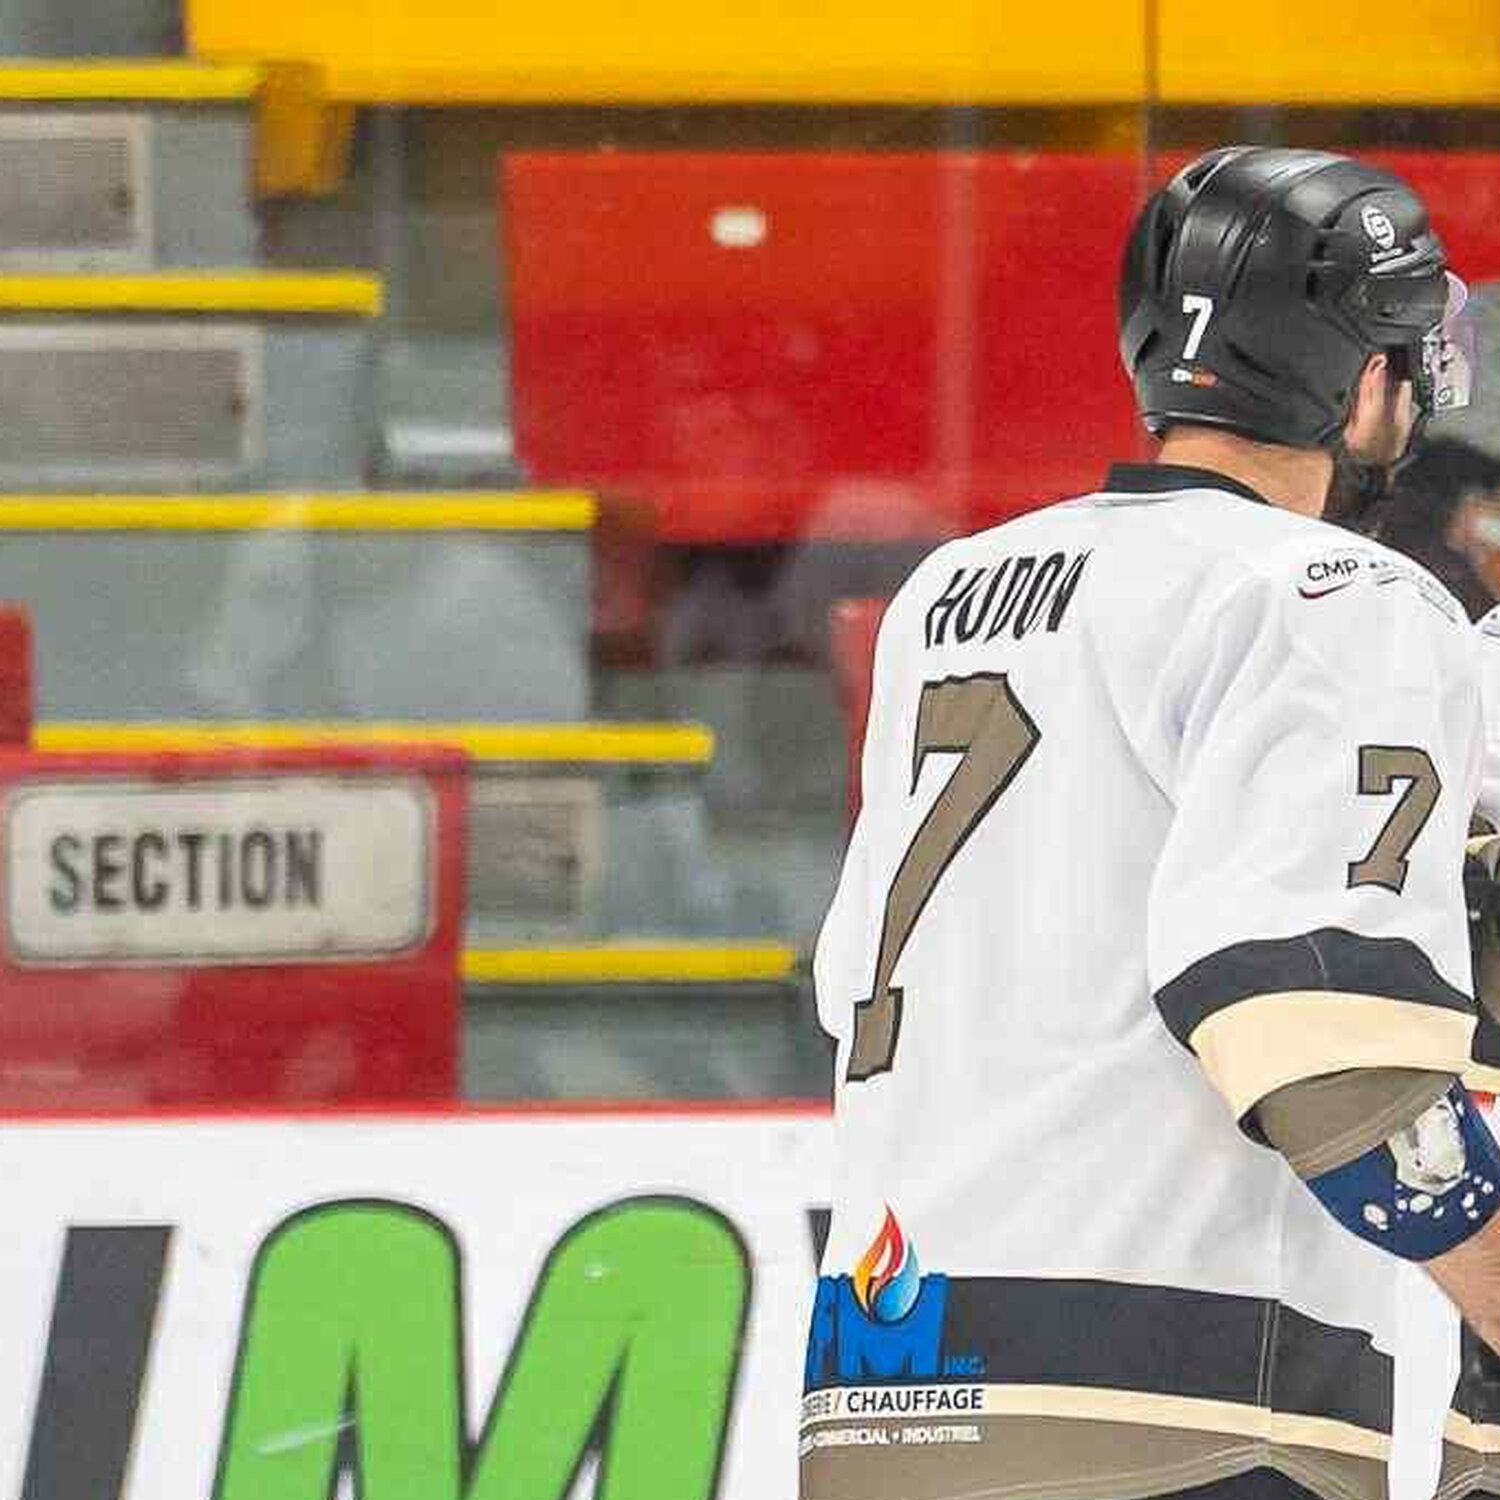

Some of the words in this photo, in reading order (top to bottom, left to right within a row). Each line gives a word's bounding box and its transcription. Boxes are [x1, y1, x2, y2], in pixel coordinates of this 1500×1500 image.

[1182, 295, 1213, 359] 7
[925, 548, 1093, 650] HUDON
[1306, 557, 1358, 582] CMP
[1346, 744, 1442, 896] 7
[49, 829, 323, 913] SECTION
[846, 670, 1042, 1082] 7
[846, 1387, 985, 1413] CHAUFFAGE
